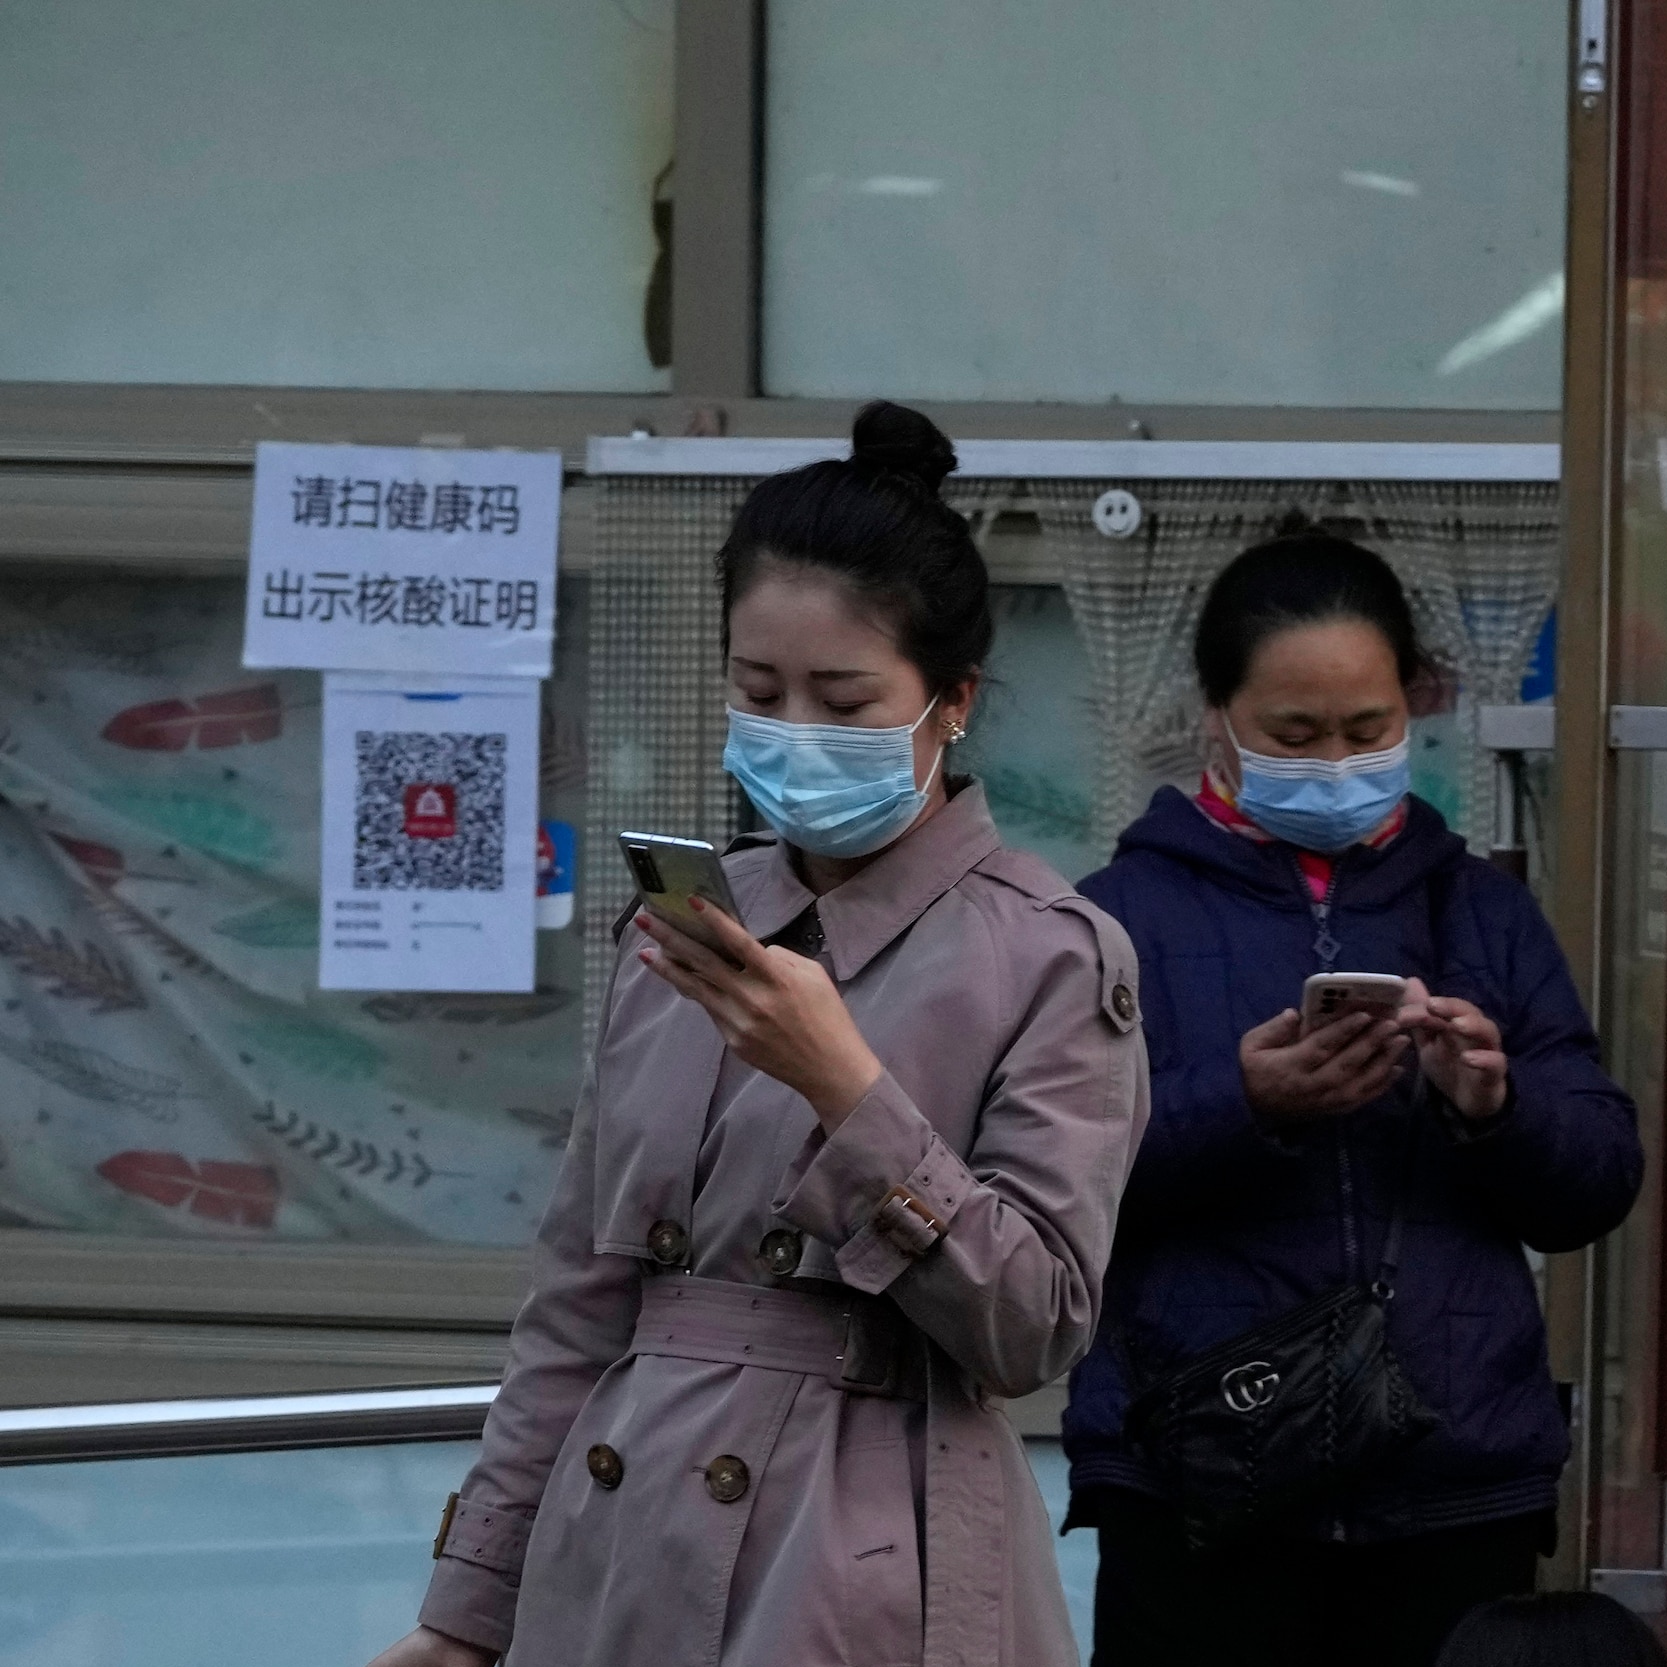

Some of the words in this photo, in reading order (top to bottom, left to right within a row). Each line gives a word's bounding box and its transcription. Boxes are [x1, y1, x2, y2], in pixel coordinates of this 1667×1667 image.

[292, 474, 521, 536] 请扫健康码
[262, 567, 539, 631] 出示核酸证明
